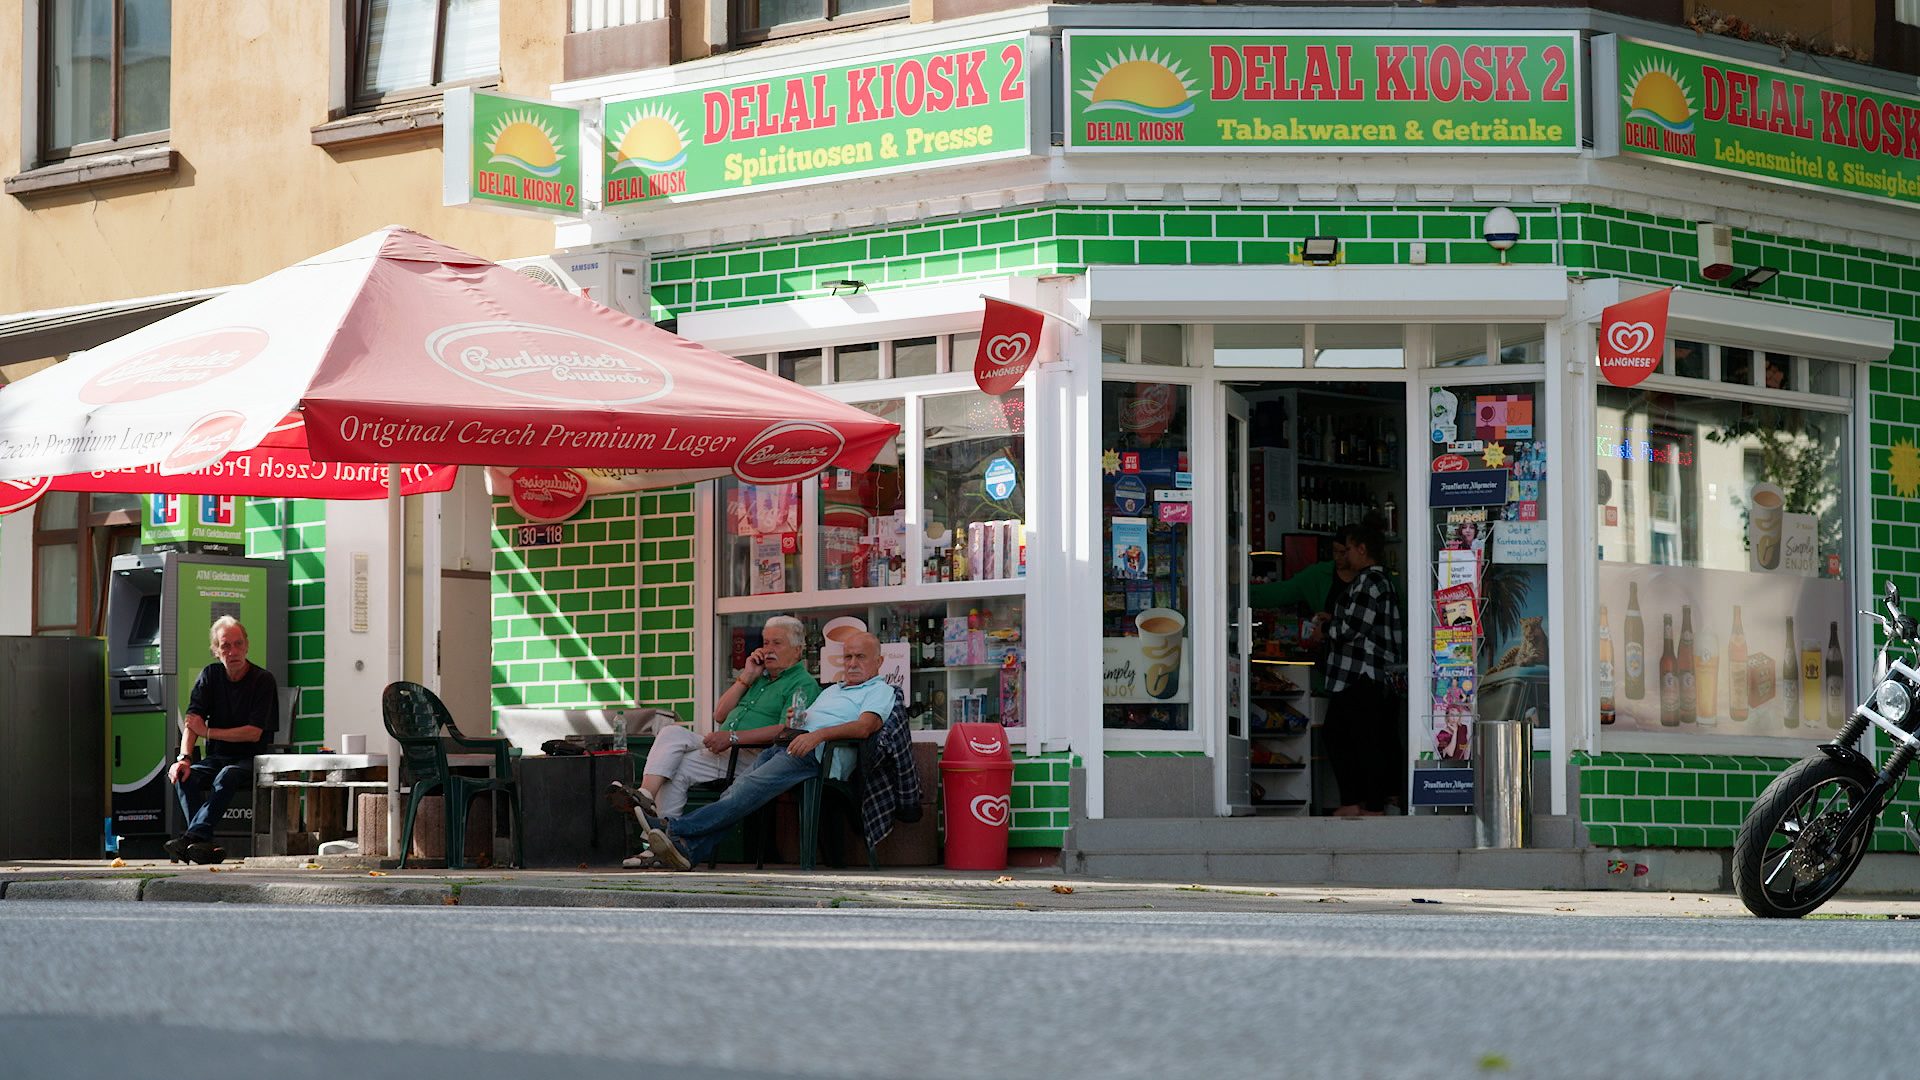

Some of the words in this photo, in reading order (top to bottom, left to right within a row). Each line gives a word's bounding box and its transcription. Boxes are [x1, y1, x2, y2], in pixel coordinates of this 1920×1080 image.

[1210, 45, 1364, 101] DELAL
[1376, 44, 1531, 102] KIOSK
[1543, 45, 1568, 101] 2
[702, 74, 837, 145] DELAL
[847, 51, 990, 124] KIOSK
[1001, 44, 1025, 101] 2
[1702, 65, 1814, 140] DELAL
[1820, 89, 1920, 160] KIOSK
[1087, 122, 1134, 142] DELAL
[1139, 121, 1185, 142] KIOSK
[1217, 118, 1397, 141] Tabakwaren
[1405, 119, 1424, 141] &
[1432, 118, 1563, 142] Getränke
[1625, 121, 1661, 151] DELAL
[1663, 128, 1696, 157] KIOSK
[724, 141, 873, 187] Spirituosen
[880, 135, 898, 159] &
[906, 123, 993, 156] Presse
[1714, 138, 1822, 181] Lebensmittel
[1827, 163, 1839, 182] &
[479, 169, 517, 198] DELAL
[522, 175, 562, 204] KIOSK
[565, 185, 575, 206] 2
[607, 177, 644, 203] DELAL
[649, 170, 687, 198] KIOSK
[571, 263, 598, 272] SAMSUNG
[460, 346, 644, 378] Budweiser
[552, 366, 650, 384] Budvar
[979, 366, 1025, 380] LANGNESE
[1603, 357, 1651, 368] LANGNESE
[44, 430, 117, 456] Premium
[120, 427, 172, 455] Lager
[340, 414, 455, 449] Original
[459, 420, 534, 447] Czech
[541, 424, 656, 451] Premium
[662, 428, 737, 457] Lager
[518, 526, 563, 545] 130-118
[1103, 660, 1136, 683] imply
[1103, 685, 1135, 697] NJOY
